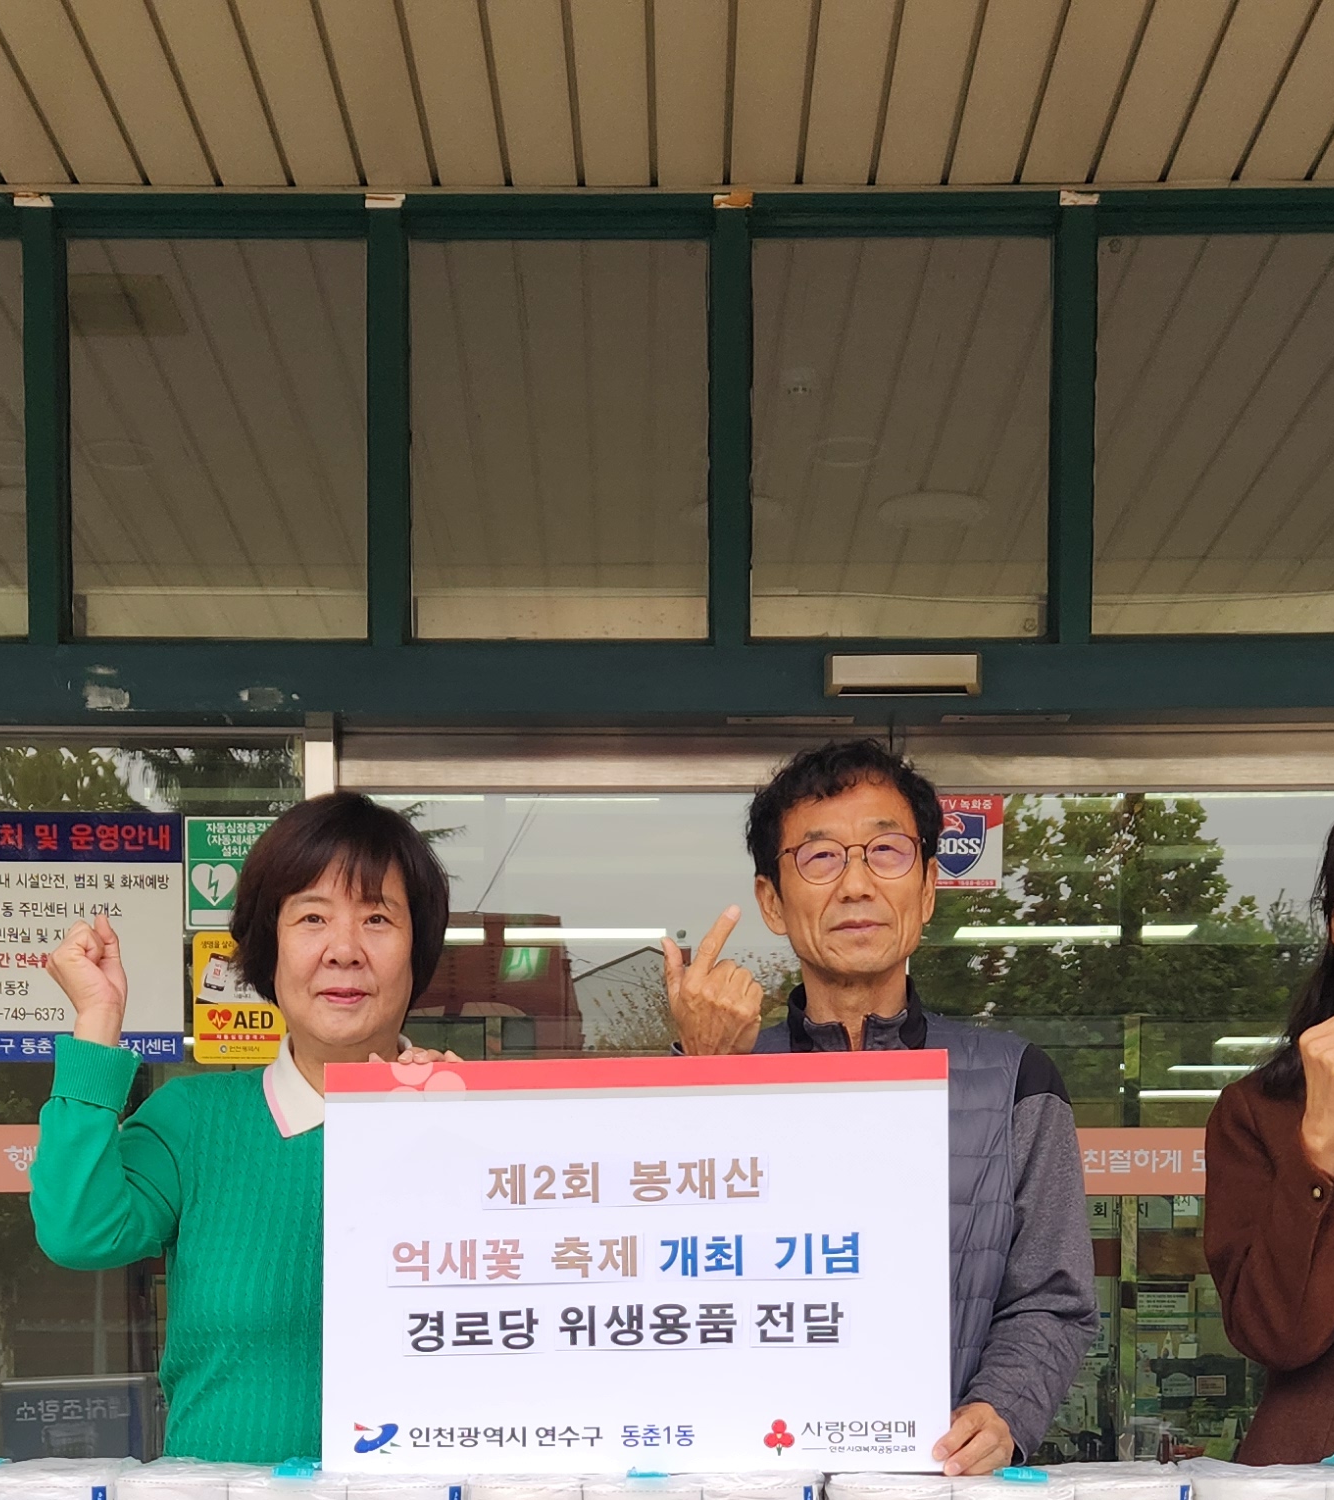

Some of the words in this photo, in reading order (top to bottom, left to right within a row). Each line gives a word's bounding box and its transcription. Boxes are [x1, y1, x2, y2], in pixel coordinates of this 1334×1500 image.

[960, 799, 992, 809] 녹화중
[35, 824, 58, 850] 및
[69, 824, 171, 851] 운영안내
[0, 873, 10, 888] 내
[17, 873, 69, 889] 시설안전,
[74, 873, 98, 889] 범죄
[103, 874, 115, 889] 및
[120, 874, 169, 889] 화재예방
[19, 902, 67, 917] 주민센터
[74, 903, 85, 918] 내
[36, 928, 48, 943] 및
[233, 1011, 273, 1029] AED
[1083, 1148, 1182, 1174] 친절하게
[486, 1161, 601, 1206] 제2회
[629, 1157, 764, 1202] 봉재산
[392, 1238, 525, 1281] 억새꽃
[551, 1235, 638, 1277] 축제
[660, 1233, 744, 1277] 개최
[775, 1231, 861, 1276] 기념
[407, 1309, 539, 1353] 경로당
[559, 1303, 738, 1347] 위생용품
[754, 1301, 845, 1344] 전달
[409, 1426, 528, 1449] 인천광역시
[534, 1425, 604, 1449] 연수구
[621, 1424, 695, 1448] 동춘1동
[801, 1420, 918, 1444] 사랑의열매
